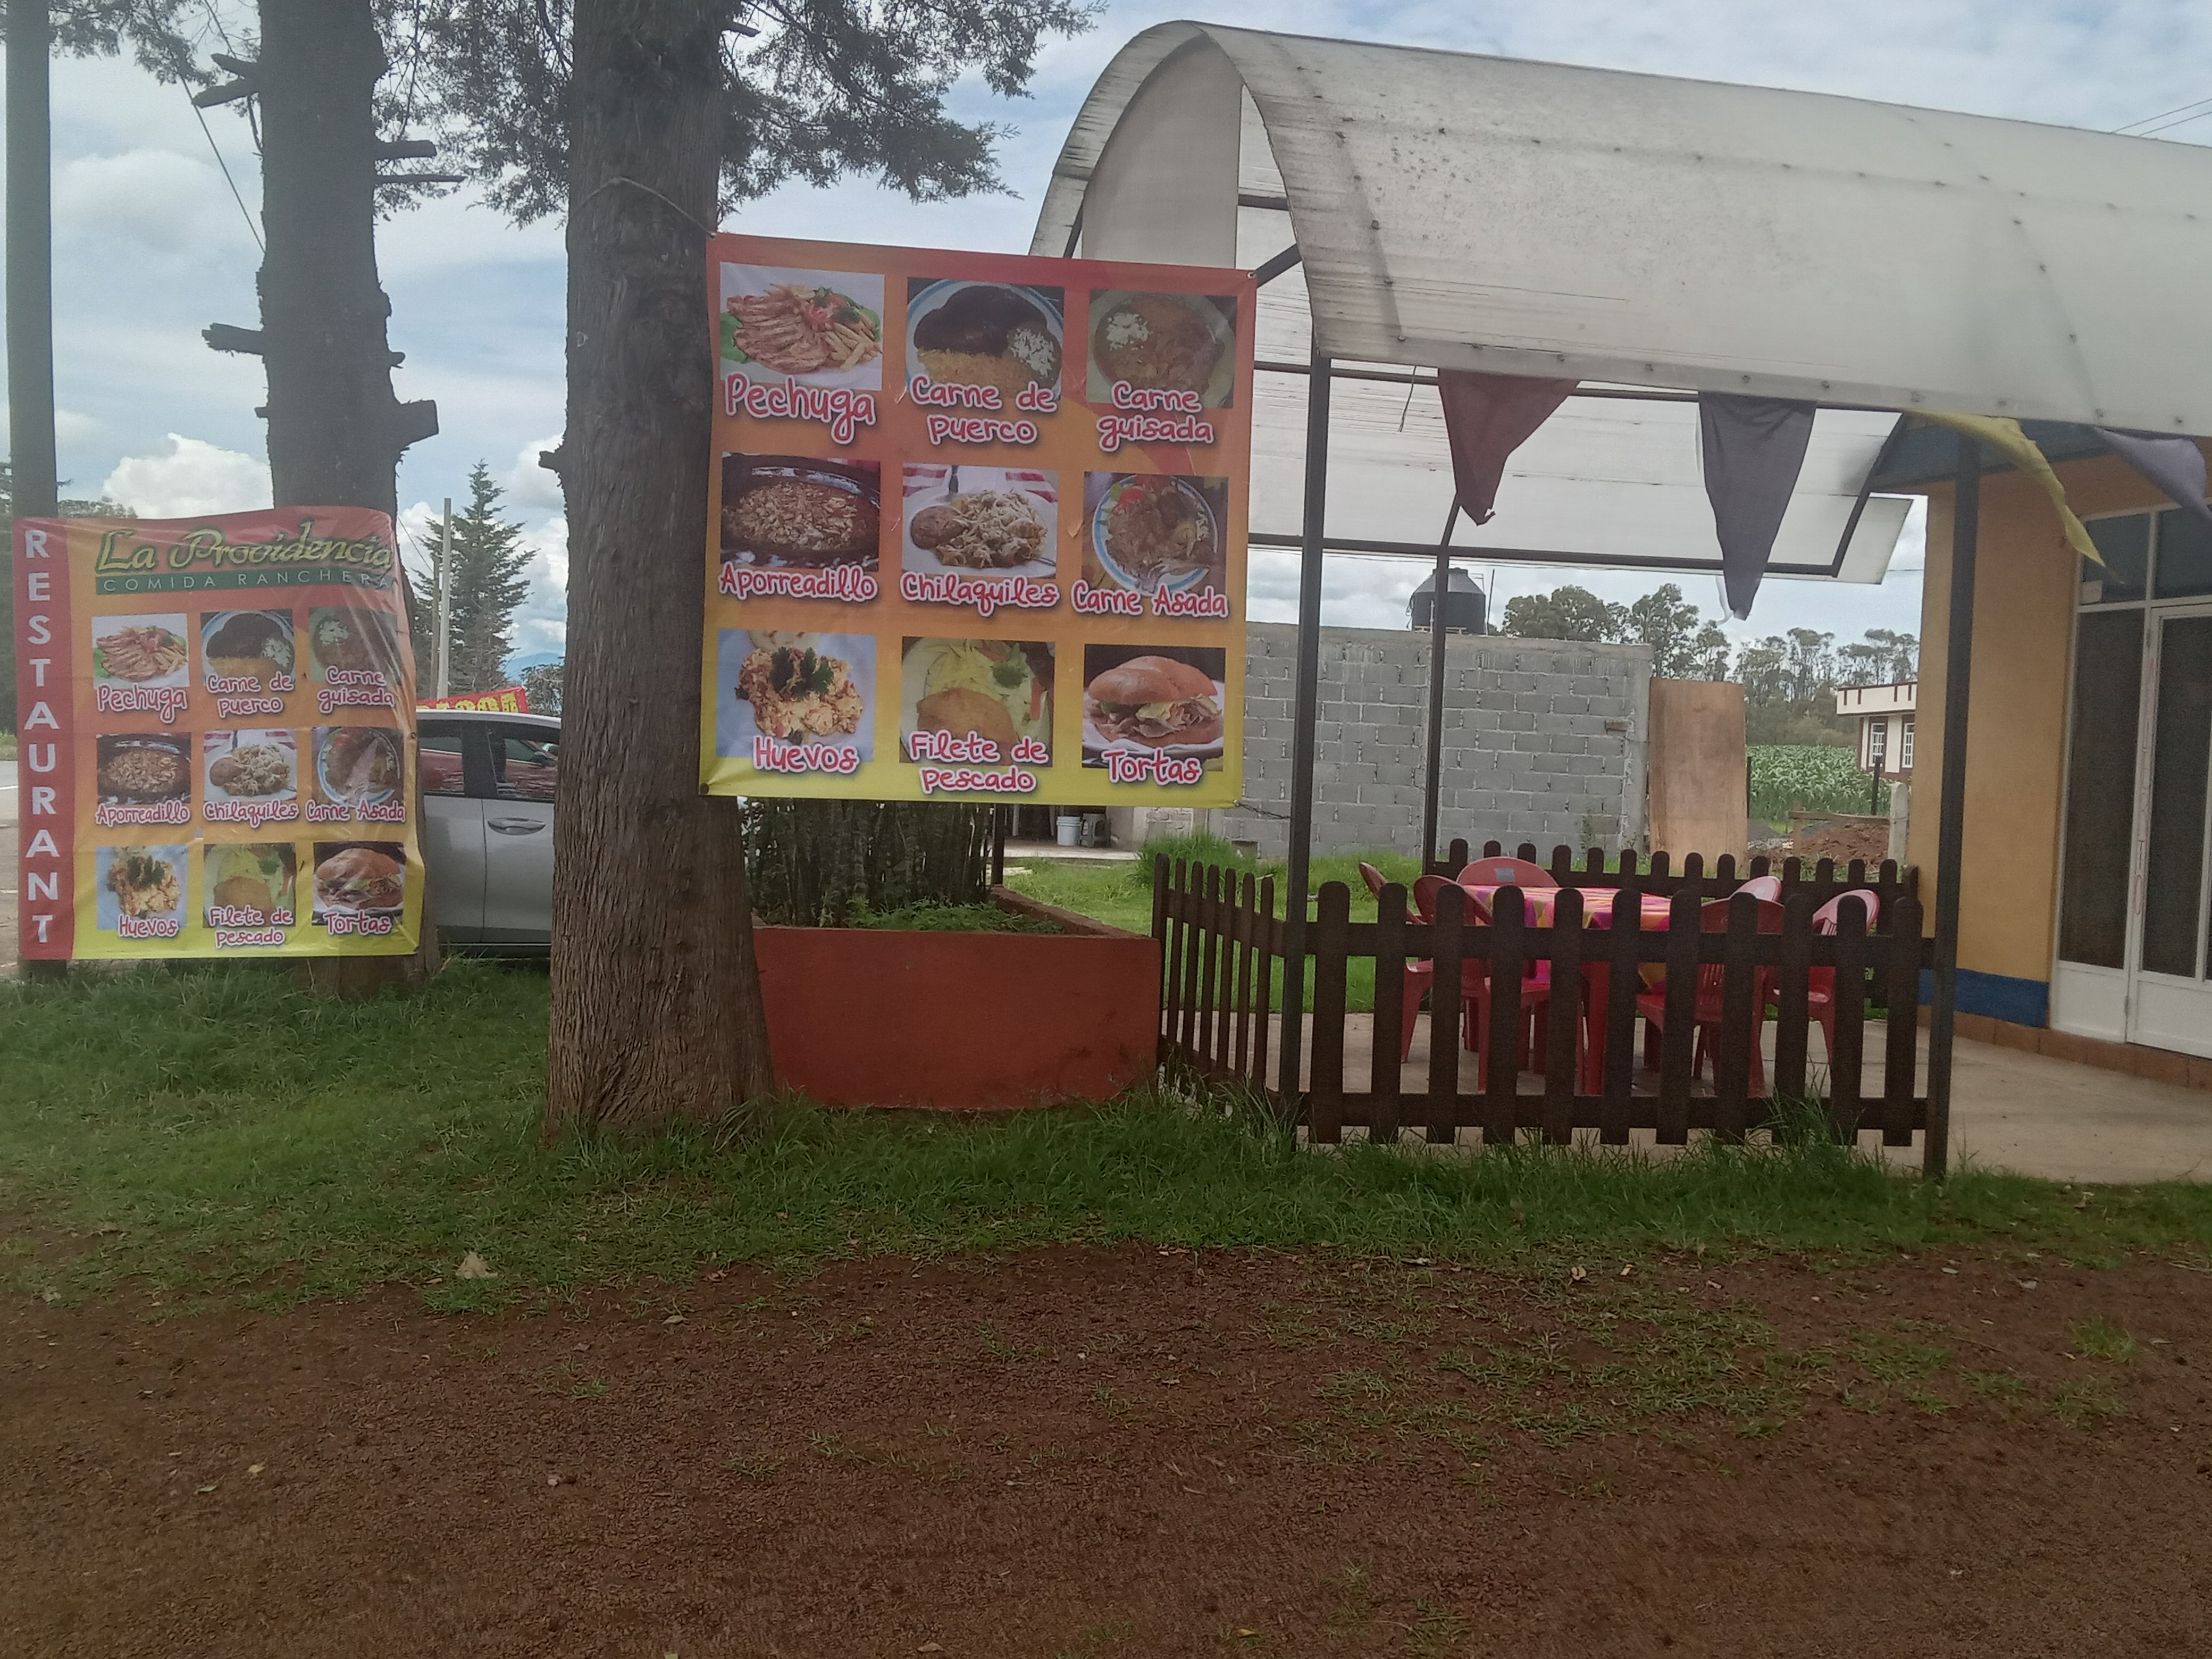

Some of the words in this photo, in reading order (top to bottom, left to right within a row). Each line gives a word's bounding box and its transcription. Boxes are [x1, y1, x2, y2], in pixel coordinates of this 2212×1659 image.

[725, 374, 876, 443] Pechuga
[911, 377, 1001, 409] Carne
[1016, 382, 1057, 412] de
[1112, 381, 1201, 413] Carne
[927, 414, 1036, 444] puerco
[1096, 416, 1214, 451] guisada
[97, 530, 156, 571] La
[169, 521, 393, 569] Providencia
[103, 576, 215, 592] COMIDA
[238, 569, 389, 589] RANCHERA
[720, 565, 878, 599] Aporreadillo
[900, 574, 1059, 617] Chilaquiles
[1071, 581, 1143, 615] Carne
[1153, 585, 1229, 617] Asada
[207, 675, 261, 692] Carne
[269, 672, 294, 691] de
[327, 667, 386, 686] Carne
[97, 684, 187, 723] Pechuga
[217, 698, 283, 717] puerco
[317, 688, 395, 714] guisada
[24, 529, 60, 945] RESTAURANT
[909, 732, 1000, 765] Filete
[1011, 738, 1049, 765] de
[753, 736, 858, 774] Huevos
[1103, 749, 1203, 785] Tortas
[919, 765, 1036, 793] pescado
[96, 801, 190, 826] Aporreadillo
[203, 800, 299, 828] Chilaquiles
[306, 800, 350, 820] Carne
[357, 801, 405, 822] Asada
[119, 915, 178, 937] Huevos
[209, 906, 264, 927] Filete
[271, 908, 294, 926] de
[324, 912, 392, 935] Tortas
[215, 929, 286, 949] pescado
